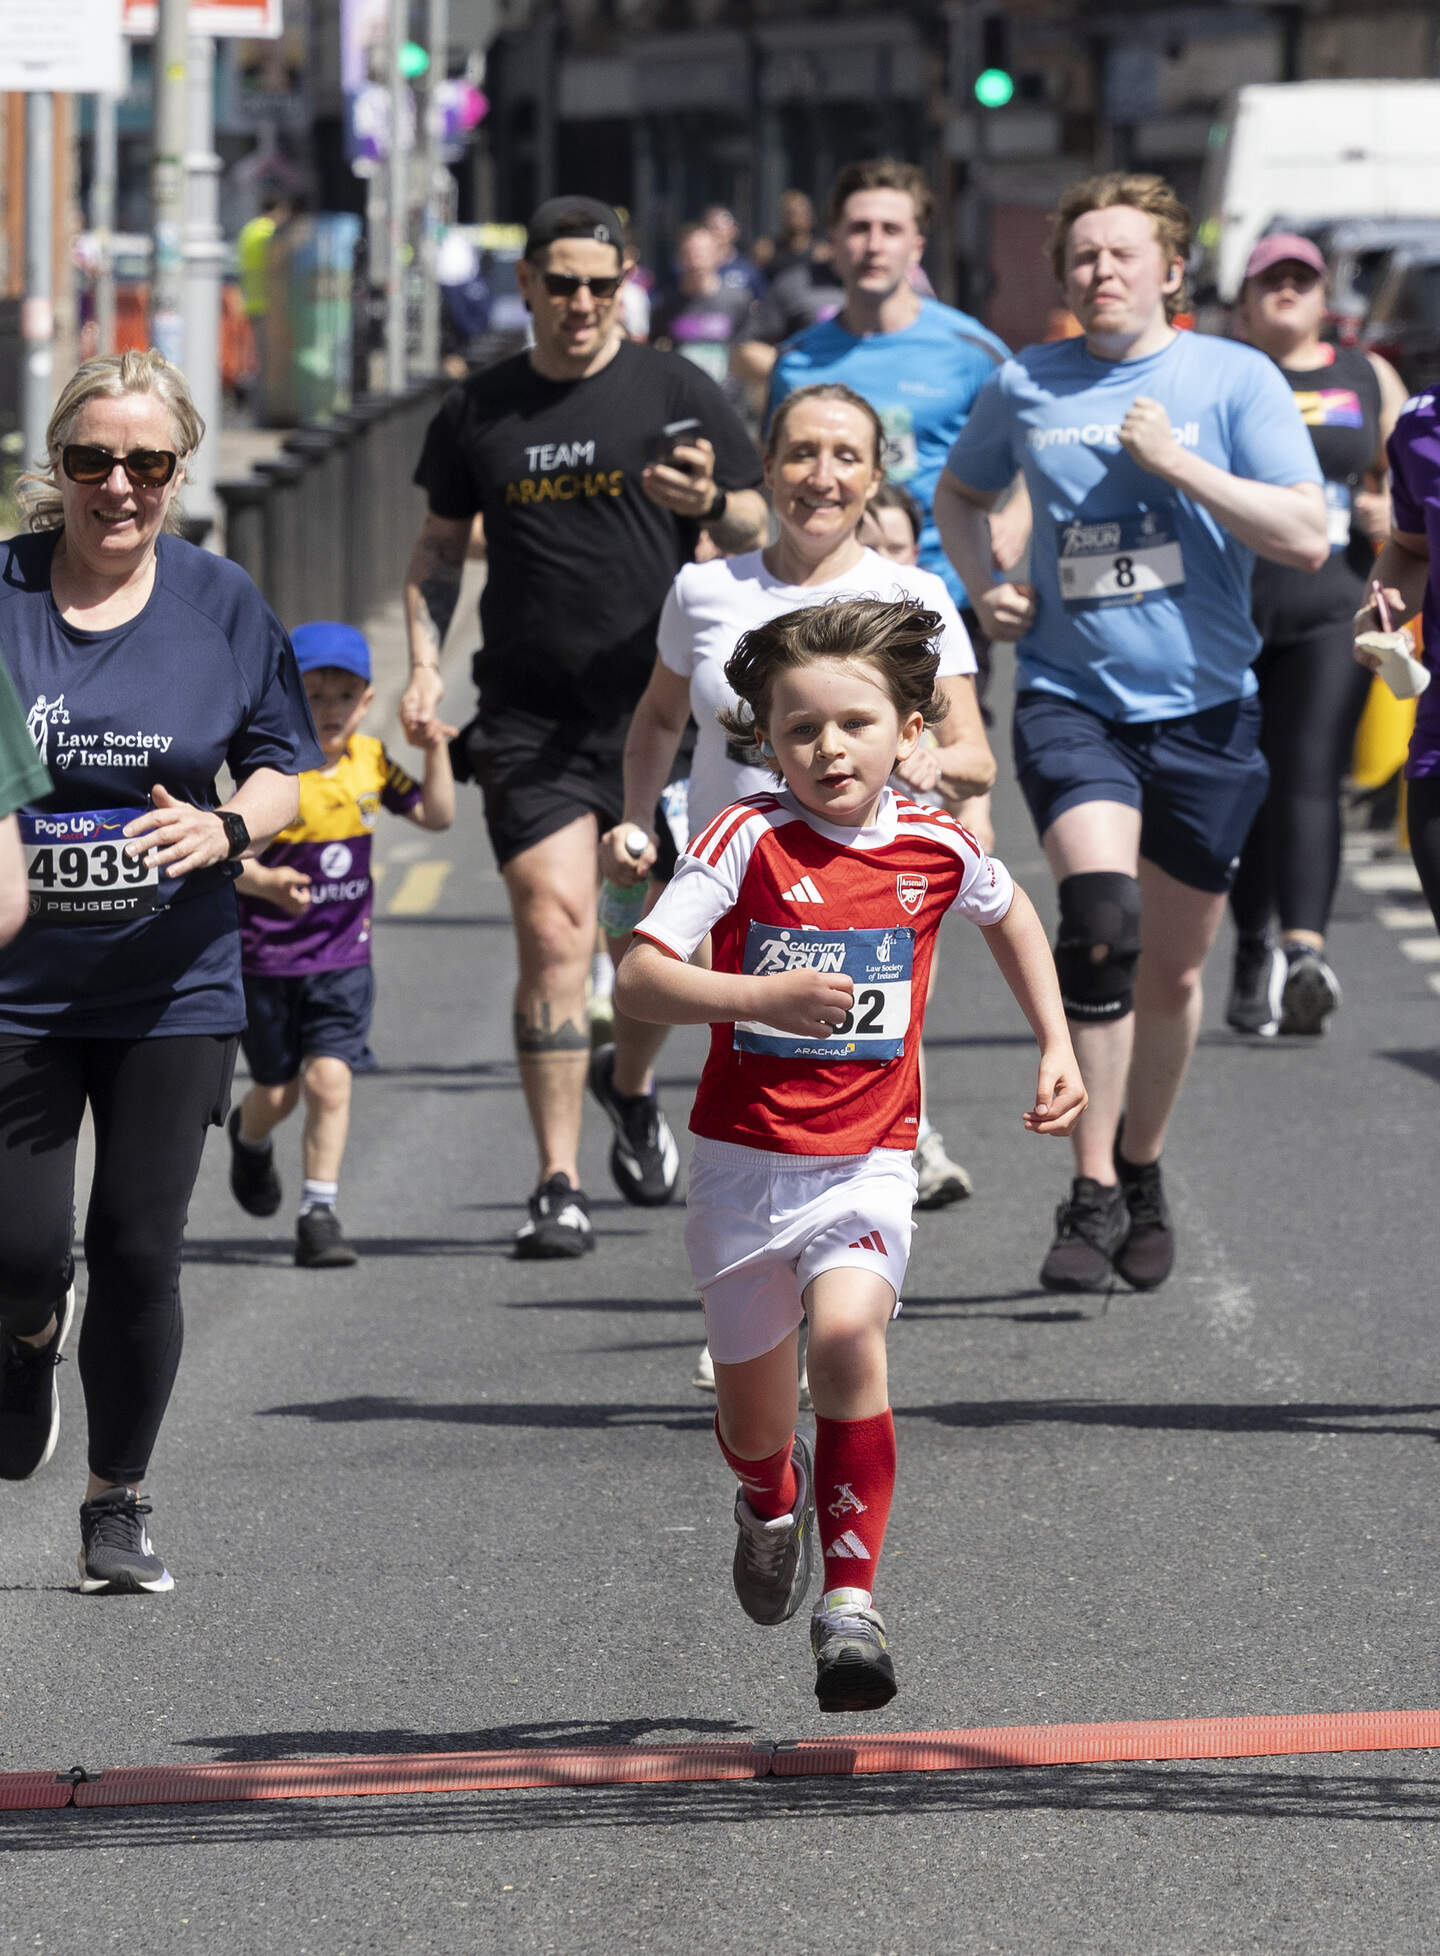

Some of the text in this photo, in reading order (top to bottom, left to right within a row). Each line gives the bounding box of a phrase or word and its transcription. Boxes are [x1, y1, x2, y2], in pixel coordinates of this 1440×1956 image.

[524, 440, 595, 472] TEAM
[506, 470, 624, 504] ARACHAS
[1115, 557, 1135, 588] 8
[57, 731, 173, 753] Law Society
[56, 749, 148, 770] of Ireland
[35, 816, 95, 838] Pop Up
[28, 845, 150, 888] 4939
[310, 878, 369, 904] URICH
[902, 879, 926, 887] Arsenal
[47, 898, 138, 912] PEUGEOT
[789, 942, 846, 953] CALCUTTA
[786, 952, 847, 973] RUN
[882, 964, 904, 973] Society
[868, 971, 899, 981] of Ireland
[795, 1046, 848, 1057] ARACHAS
